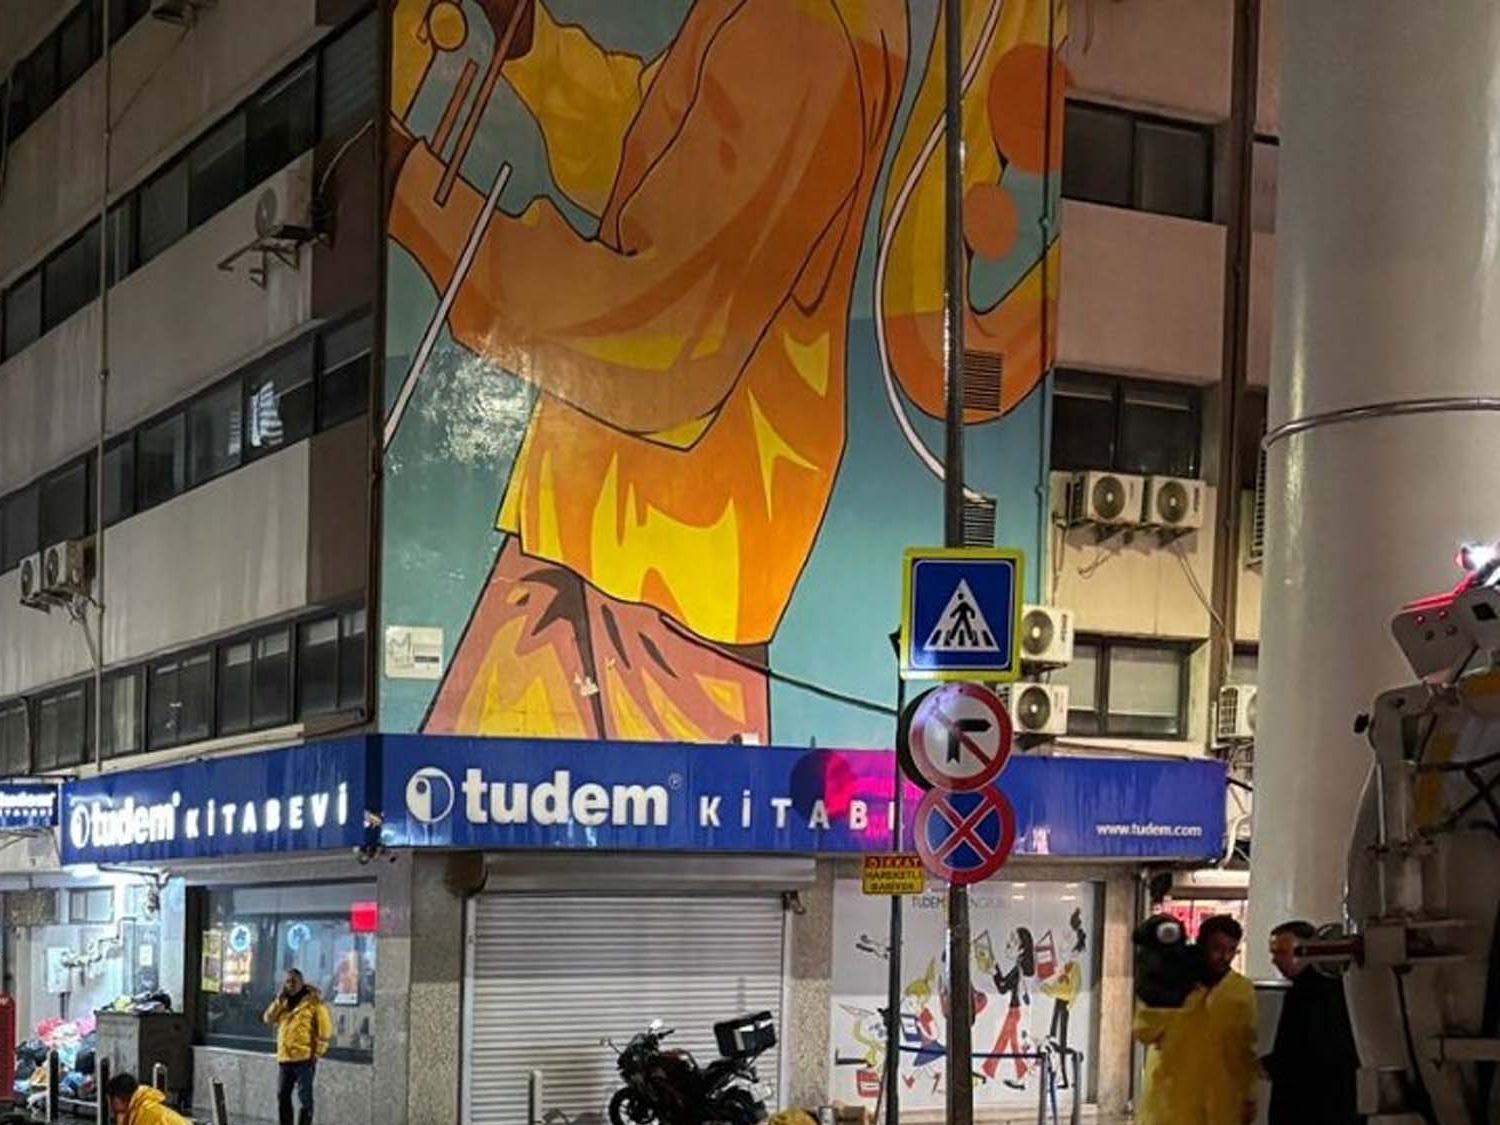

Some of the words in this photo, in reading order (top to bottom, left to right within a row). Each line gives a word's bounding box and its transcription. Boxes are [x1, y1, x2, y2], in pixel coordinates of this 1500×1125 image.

[91, 795, 175, 847] tudem
[186, 782, 348, 839] KİTABEVİ
[461, 767, 669, 827] tudem
[1095, 823, 1203, 837] www.tudem.com
